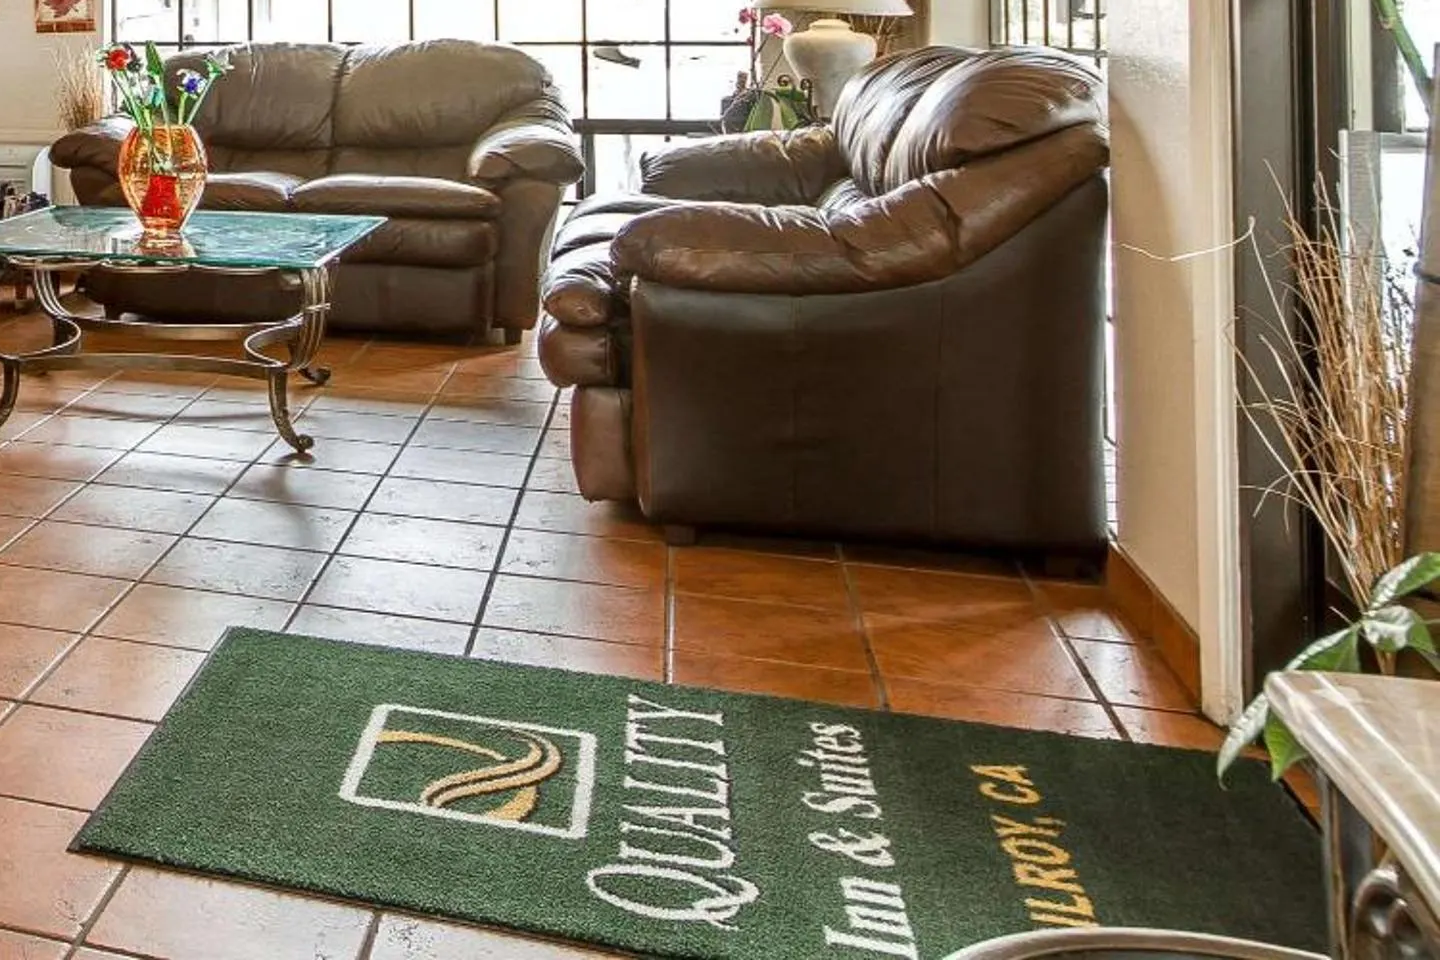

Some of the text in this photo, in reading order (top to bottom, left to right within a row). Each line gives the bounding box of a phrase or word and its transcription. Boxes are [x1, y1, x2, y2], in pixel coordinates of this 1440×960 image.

[586, 693, 760, 931] QUALITY
[796, 721, 919, 960] Inn & Suites
[969, 763, 1042, 804] CA
